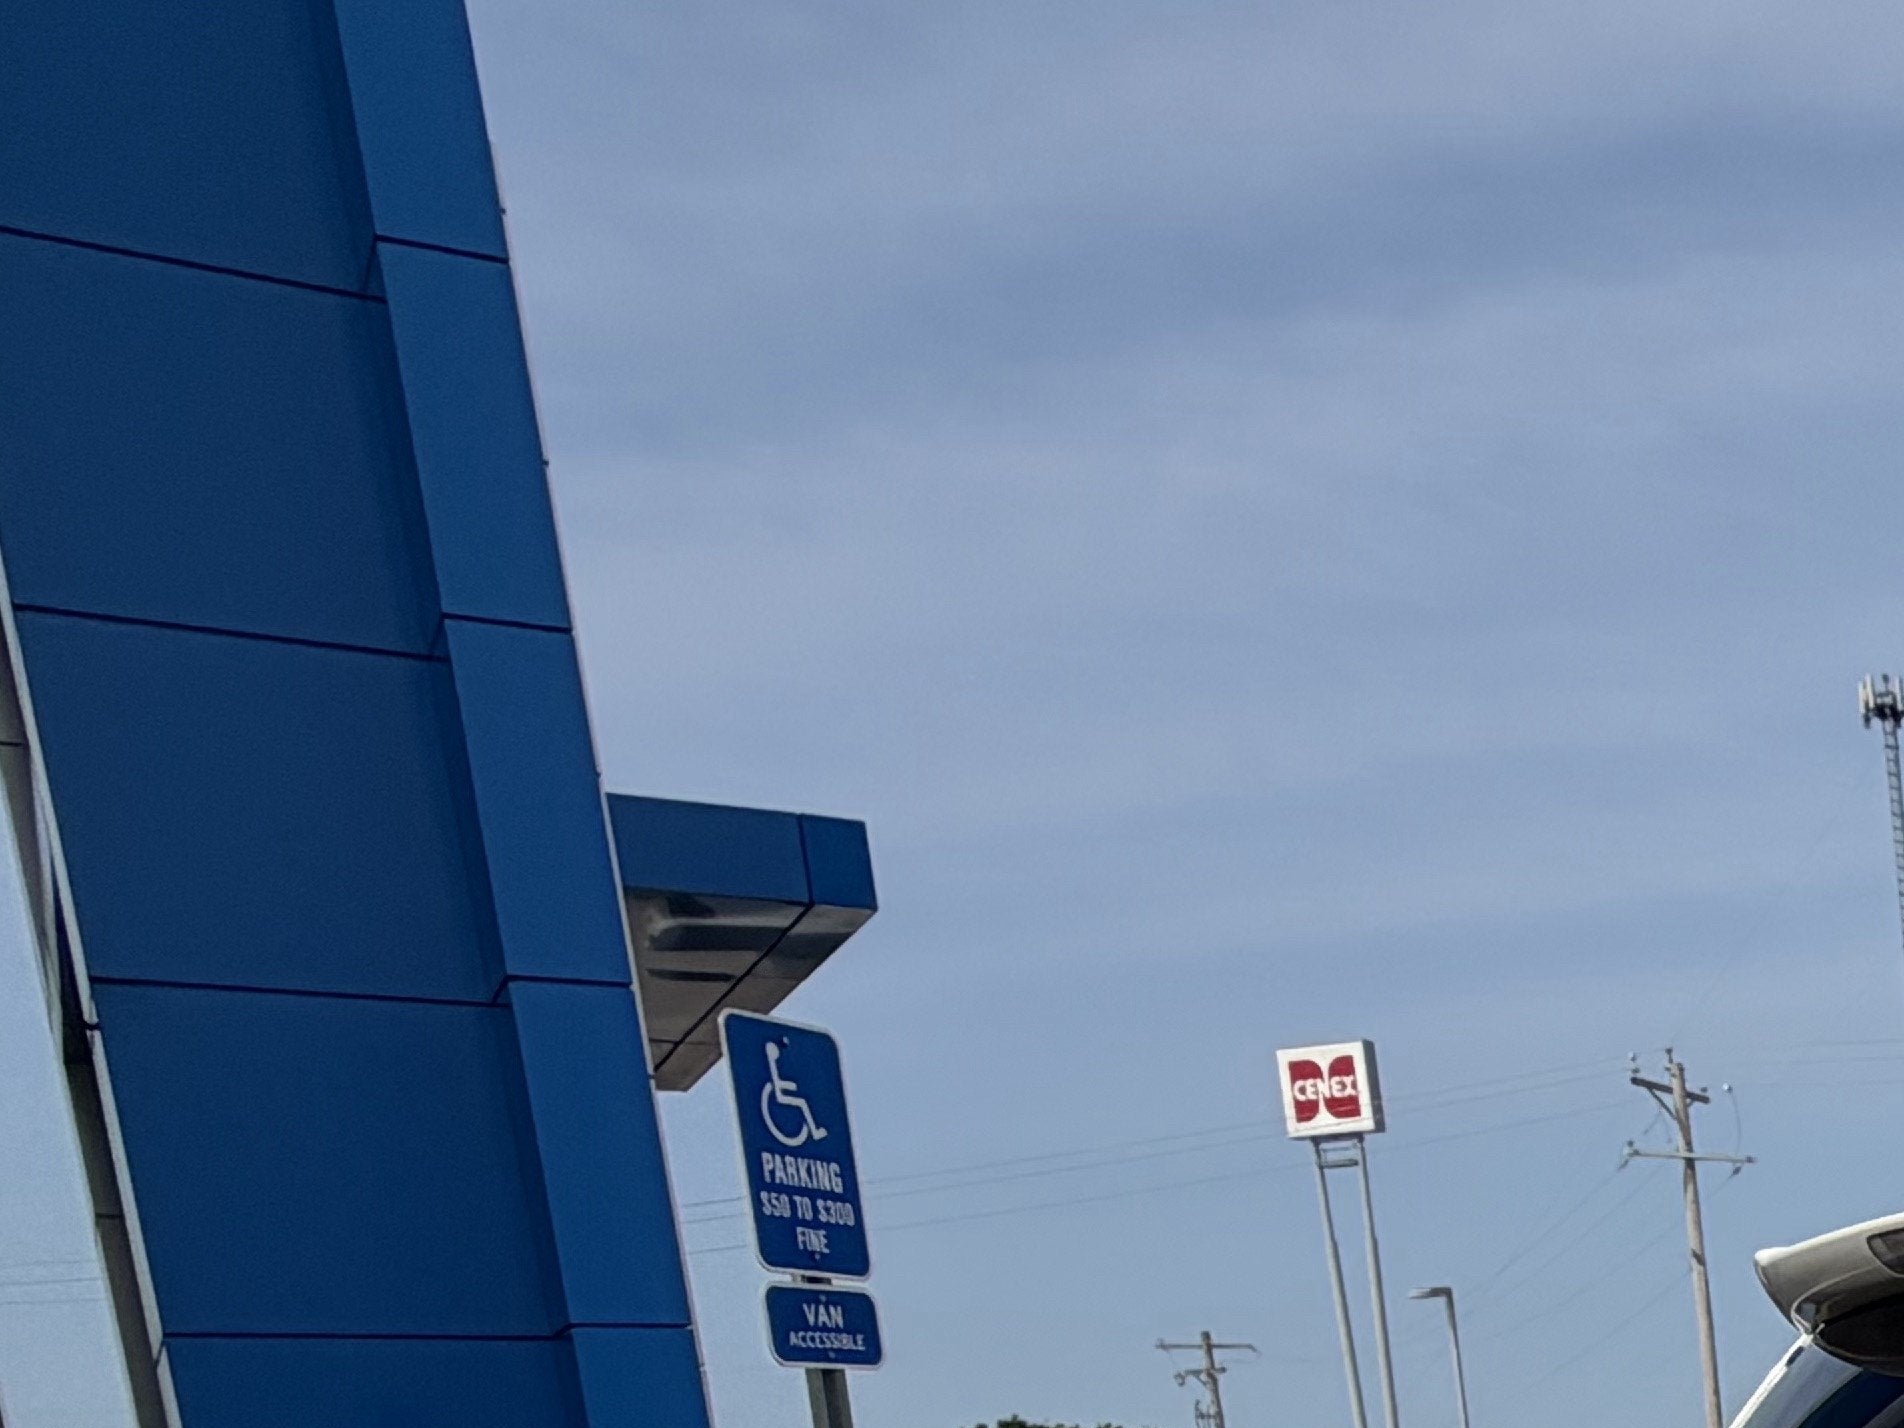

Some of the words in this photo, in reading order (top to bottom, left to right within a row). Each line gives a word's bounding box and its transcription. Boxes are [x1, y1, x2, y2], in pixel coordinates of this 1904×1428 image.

[1294, 1075, 1358, 1102] CENEX
[761, 1151, 843, 1194] PARKING
[760, 1190, 792, 1218] $50
[792, 1194, 813, 1221] TO
[816, 1198, 855, 1227] $300
[796, 1226, 830, 1254] FINE
[802, 1302, 844, 1329] VAN
[789, 1330, 866, 1351] ACCESSIBLE
